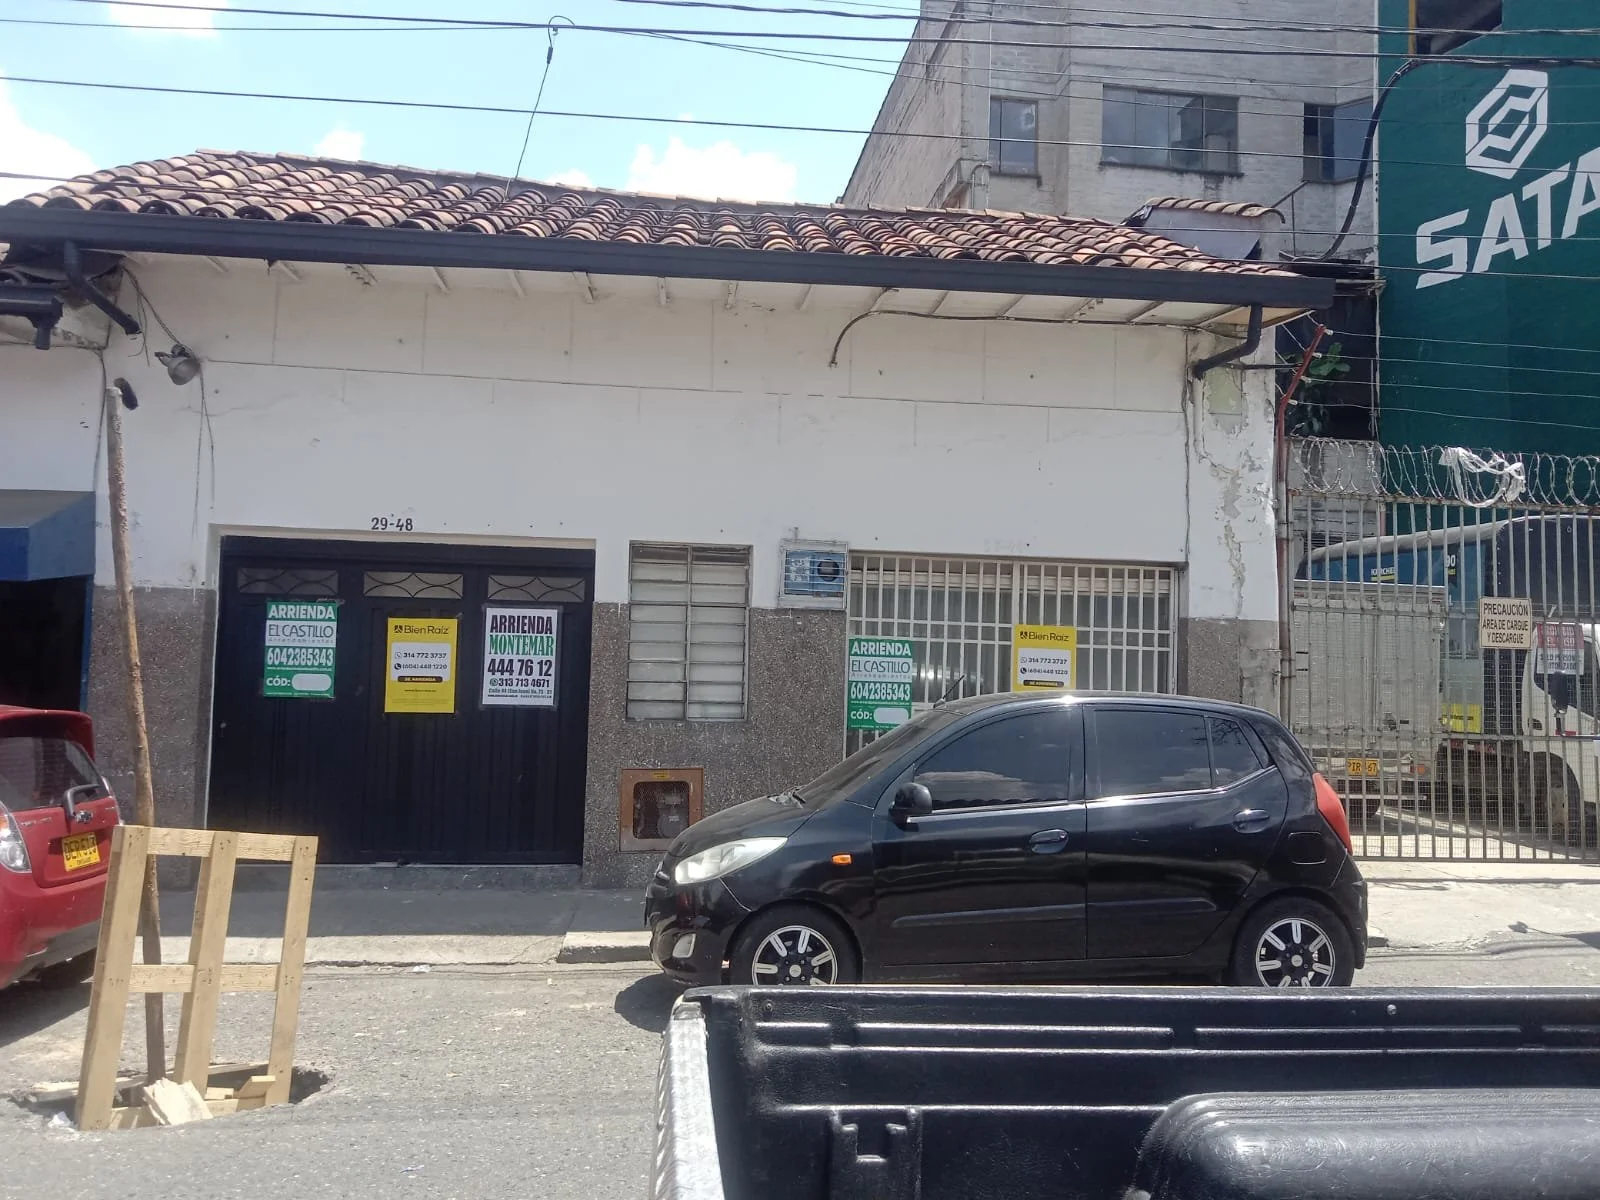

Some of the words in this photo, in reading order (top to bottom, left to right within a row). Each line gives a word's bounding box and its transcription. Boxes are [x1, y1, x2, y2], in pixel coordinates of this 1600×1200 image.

[371, 516, 413, 531] 29-48
[268, 604, 336, 620] ARRIENDA
[1483, 601, 1529, 616] PRECAUCIÓN
[268, 624, 281, 637] EL
[282, 624, 334, 638] CASTILLO
[490, 614, 553, 635] ARRIENDA
[1506, 619, 1529, 631] CARGUE
[489, 634, 554, 656] MONTEMAR
[1491, 632, 1524, 644] DESCARGUE
[851, 641, 911, 656] ARRIENDA
[267, 647, 334, 666] 6042385343
[488, 658, 514, 676] 444
[517, 659, 534, 676] 76
[537, 660, 552, 676] 12
[851, 659, 861, 672] EL
[863, 660, 911, 674] CASTILLO
[266, 675, 291, 687] CÓD:
[498, 678, 514, 687] 313
[515, 678, 529, 688] 713
[530, 679, 550, 689] 4671
[850, 682, 911, 701] 6042385343
[850, 709, 873, 720] CÓD:
